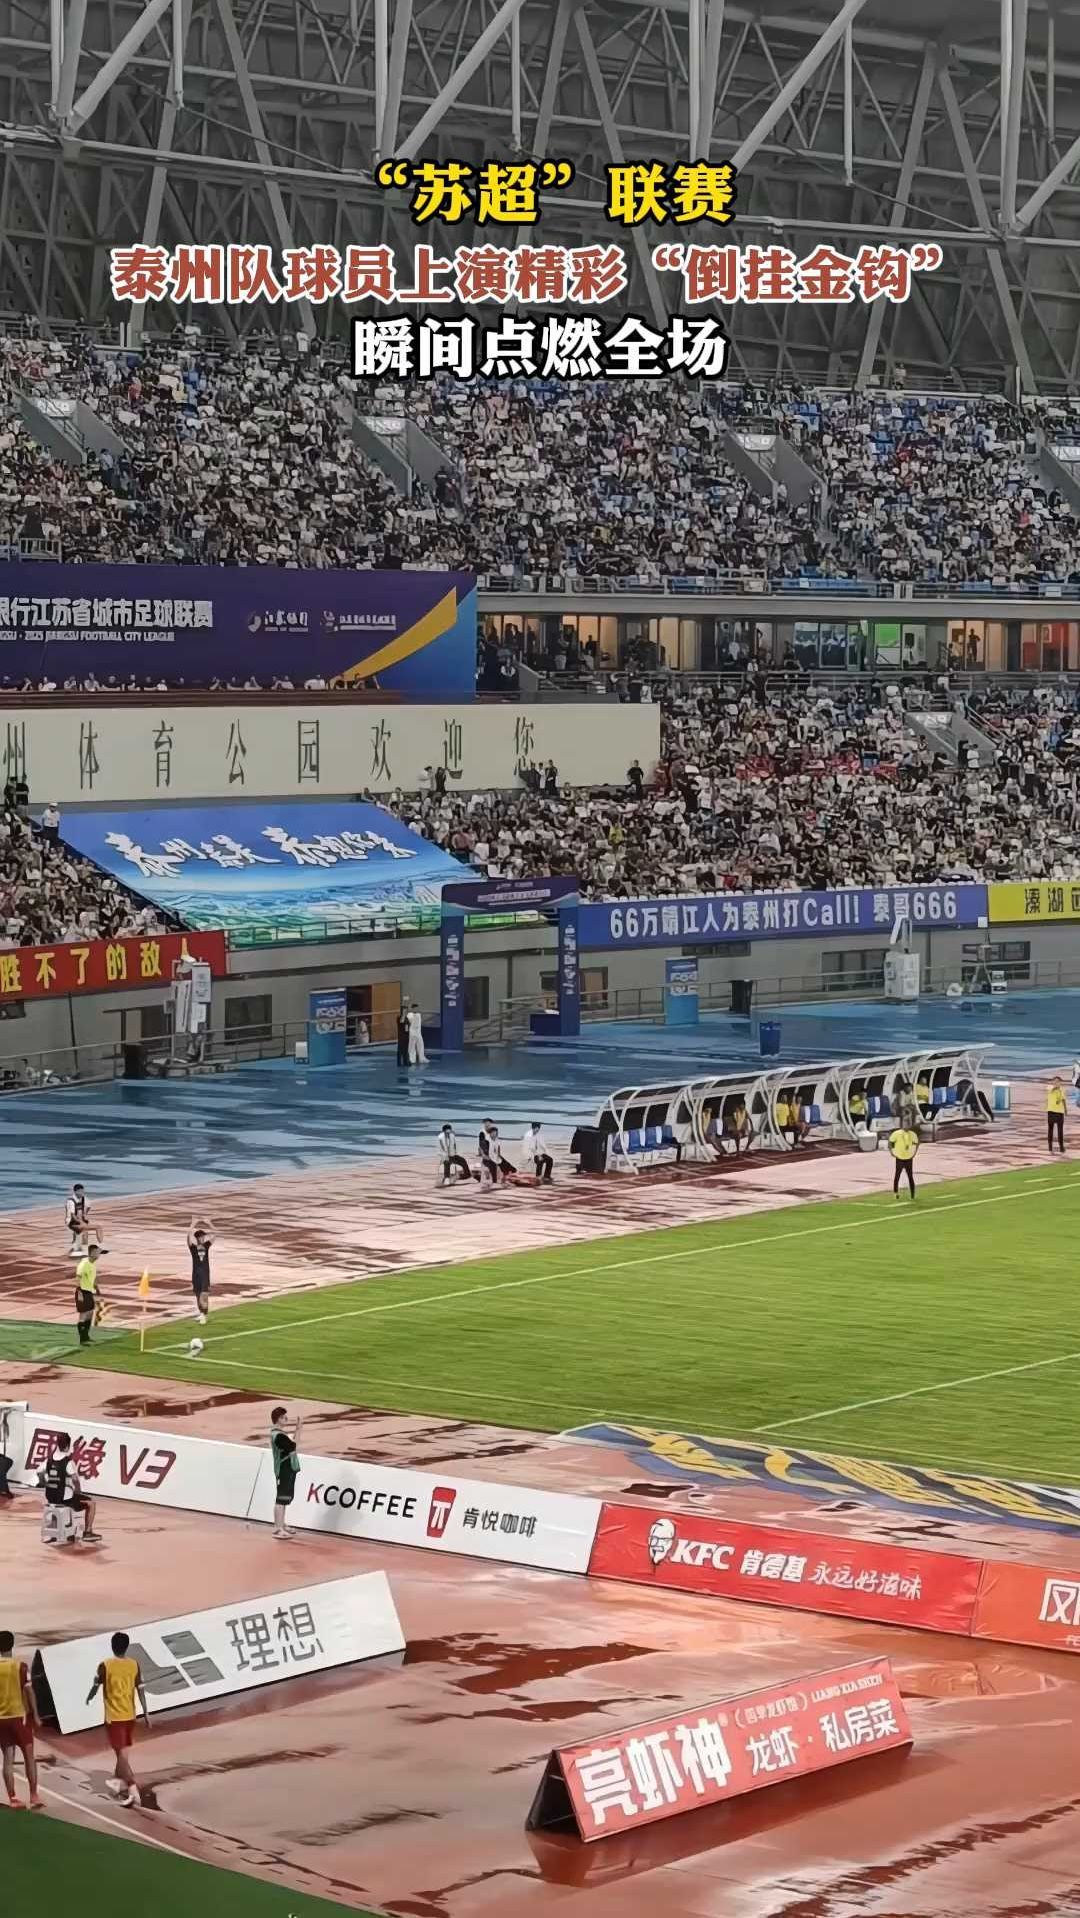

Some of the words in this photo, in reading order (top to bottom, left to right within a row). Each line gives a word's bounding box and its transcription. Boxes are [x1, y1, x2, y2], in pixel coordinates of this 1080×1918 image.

[119, 1444, 177, 1490] V3
[307, 1482, 418, 1519] KCOFFEE
[463, 1507, 538, 1538] 肯悦咖啡
[671, 1539, 735, 1571] KFC
[740, 1549, 807, 1583] 肯德基
[807, 1561, 922, 1600] 永远好滋味
[225, 1602, 325, 1672] 理想
